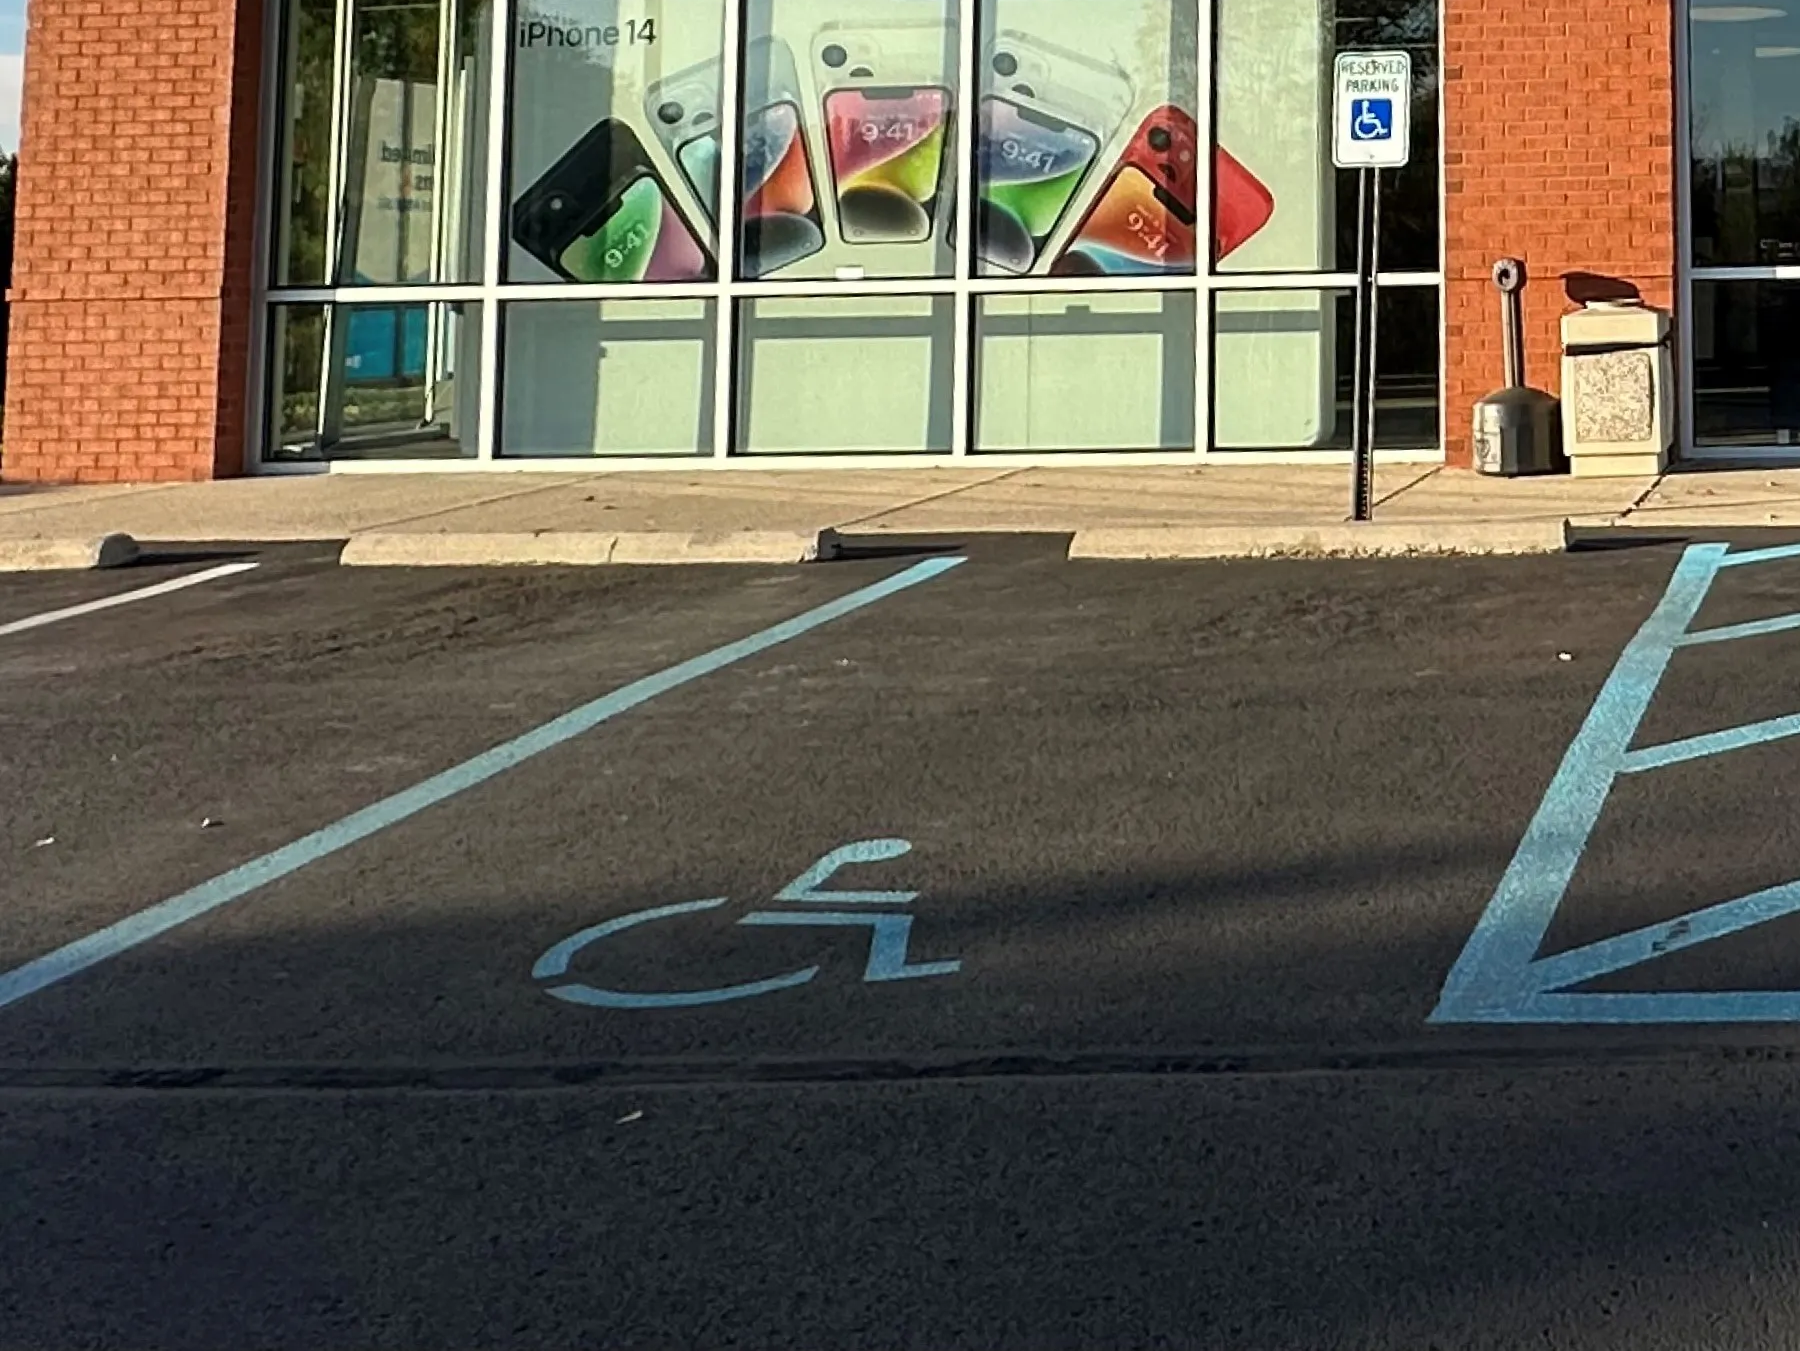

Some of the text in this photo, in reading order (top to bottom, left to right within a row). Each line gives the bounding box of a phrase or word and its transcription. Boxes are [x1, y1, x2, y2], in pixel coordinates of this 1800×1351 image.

[519, 18, 658, 48] iPhone 14
[1340, 59, 1407, 76] RESERVED
[1345, 77, 1400, 93] PARKING
[861, 122, 914, 144] 9:41
[1127, 212, 1170, 257] 9:41
